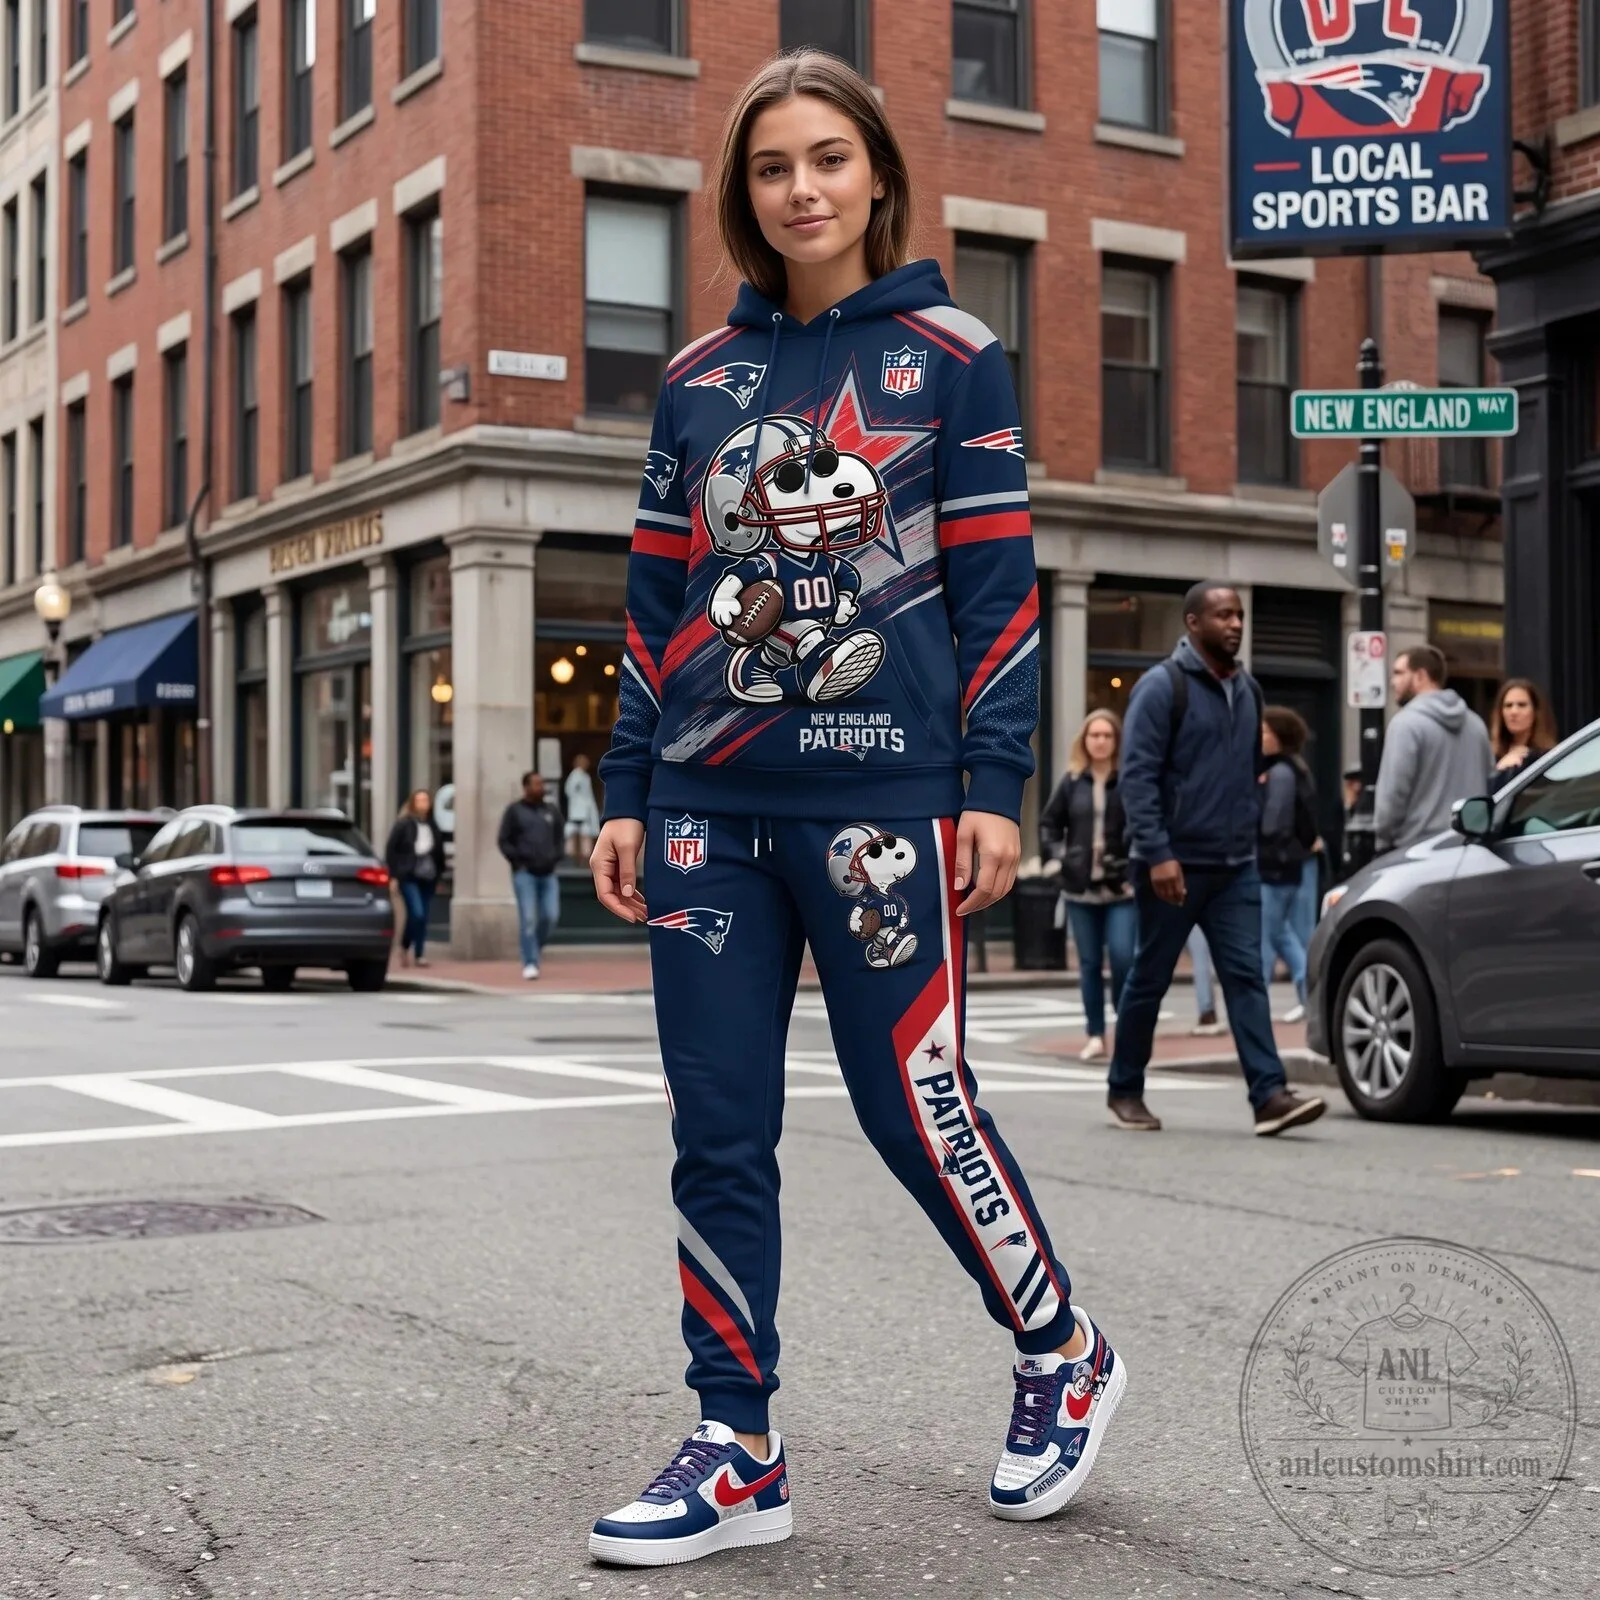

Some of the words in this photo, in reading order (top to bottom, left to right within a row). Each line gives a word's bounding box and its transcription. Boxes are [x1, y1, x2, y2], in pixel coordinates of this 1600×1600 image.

[1311, 141, 1433, 184] LOCAL
[1252, 186, 1401, 231] SPORTS
[1411, 182, 1489, 223] BAR
[886, 369, 919, 391] NFL
[1303, 398, 1355, 430] NEW
[1363, 397, 1472, 430] ENGLAND
[1477, 397, 1508, 414] WAY
[793, 576, 831, 611] 00
[810, 713, 835, 726] NEW
[839, 713, 892, 726] ENGLAND
[799, 728, 905, 753] PATRIOTS
[669, 840, 703, 867] NFL
[883, 904, 898, 917] 00
[914, 1071, 1010, 1227] PATRIOTS
